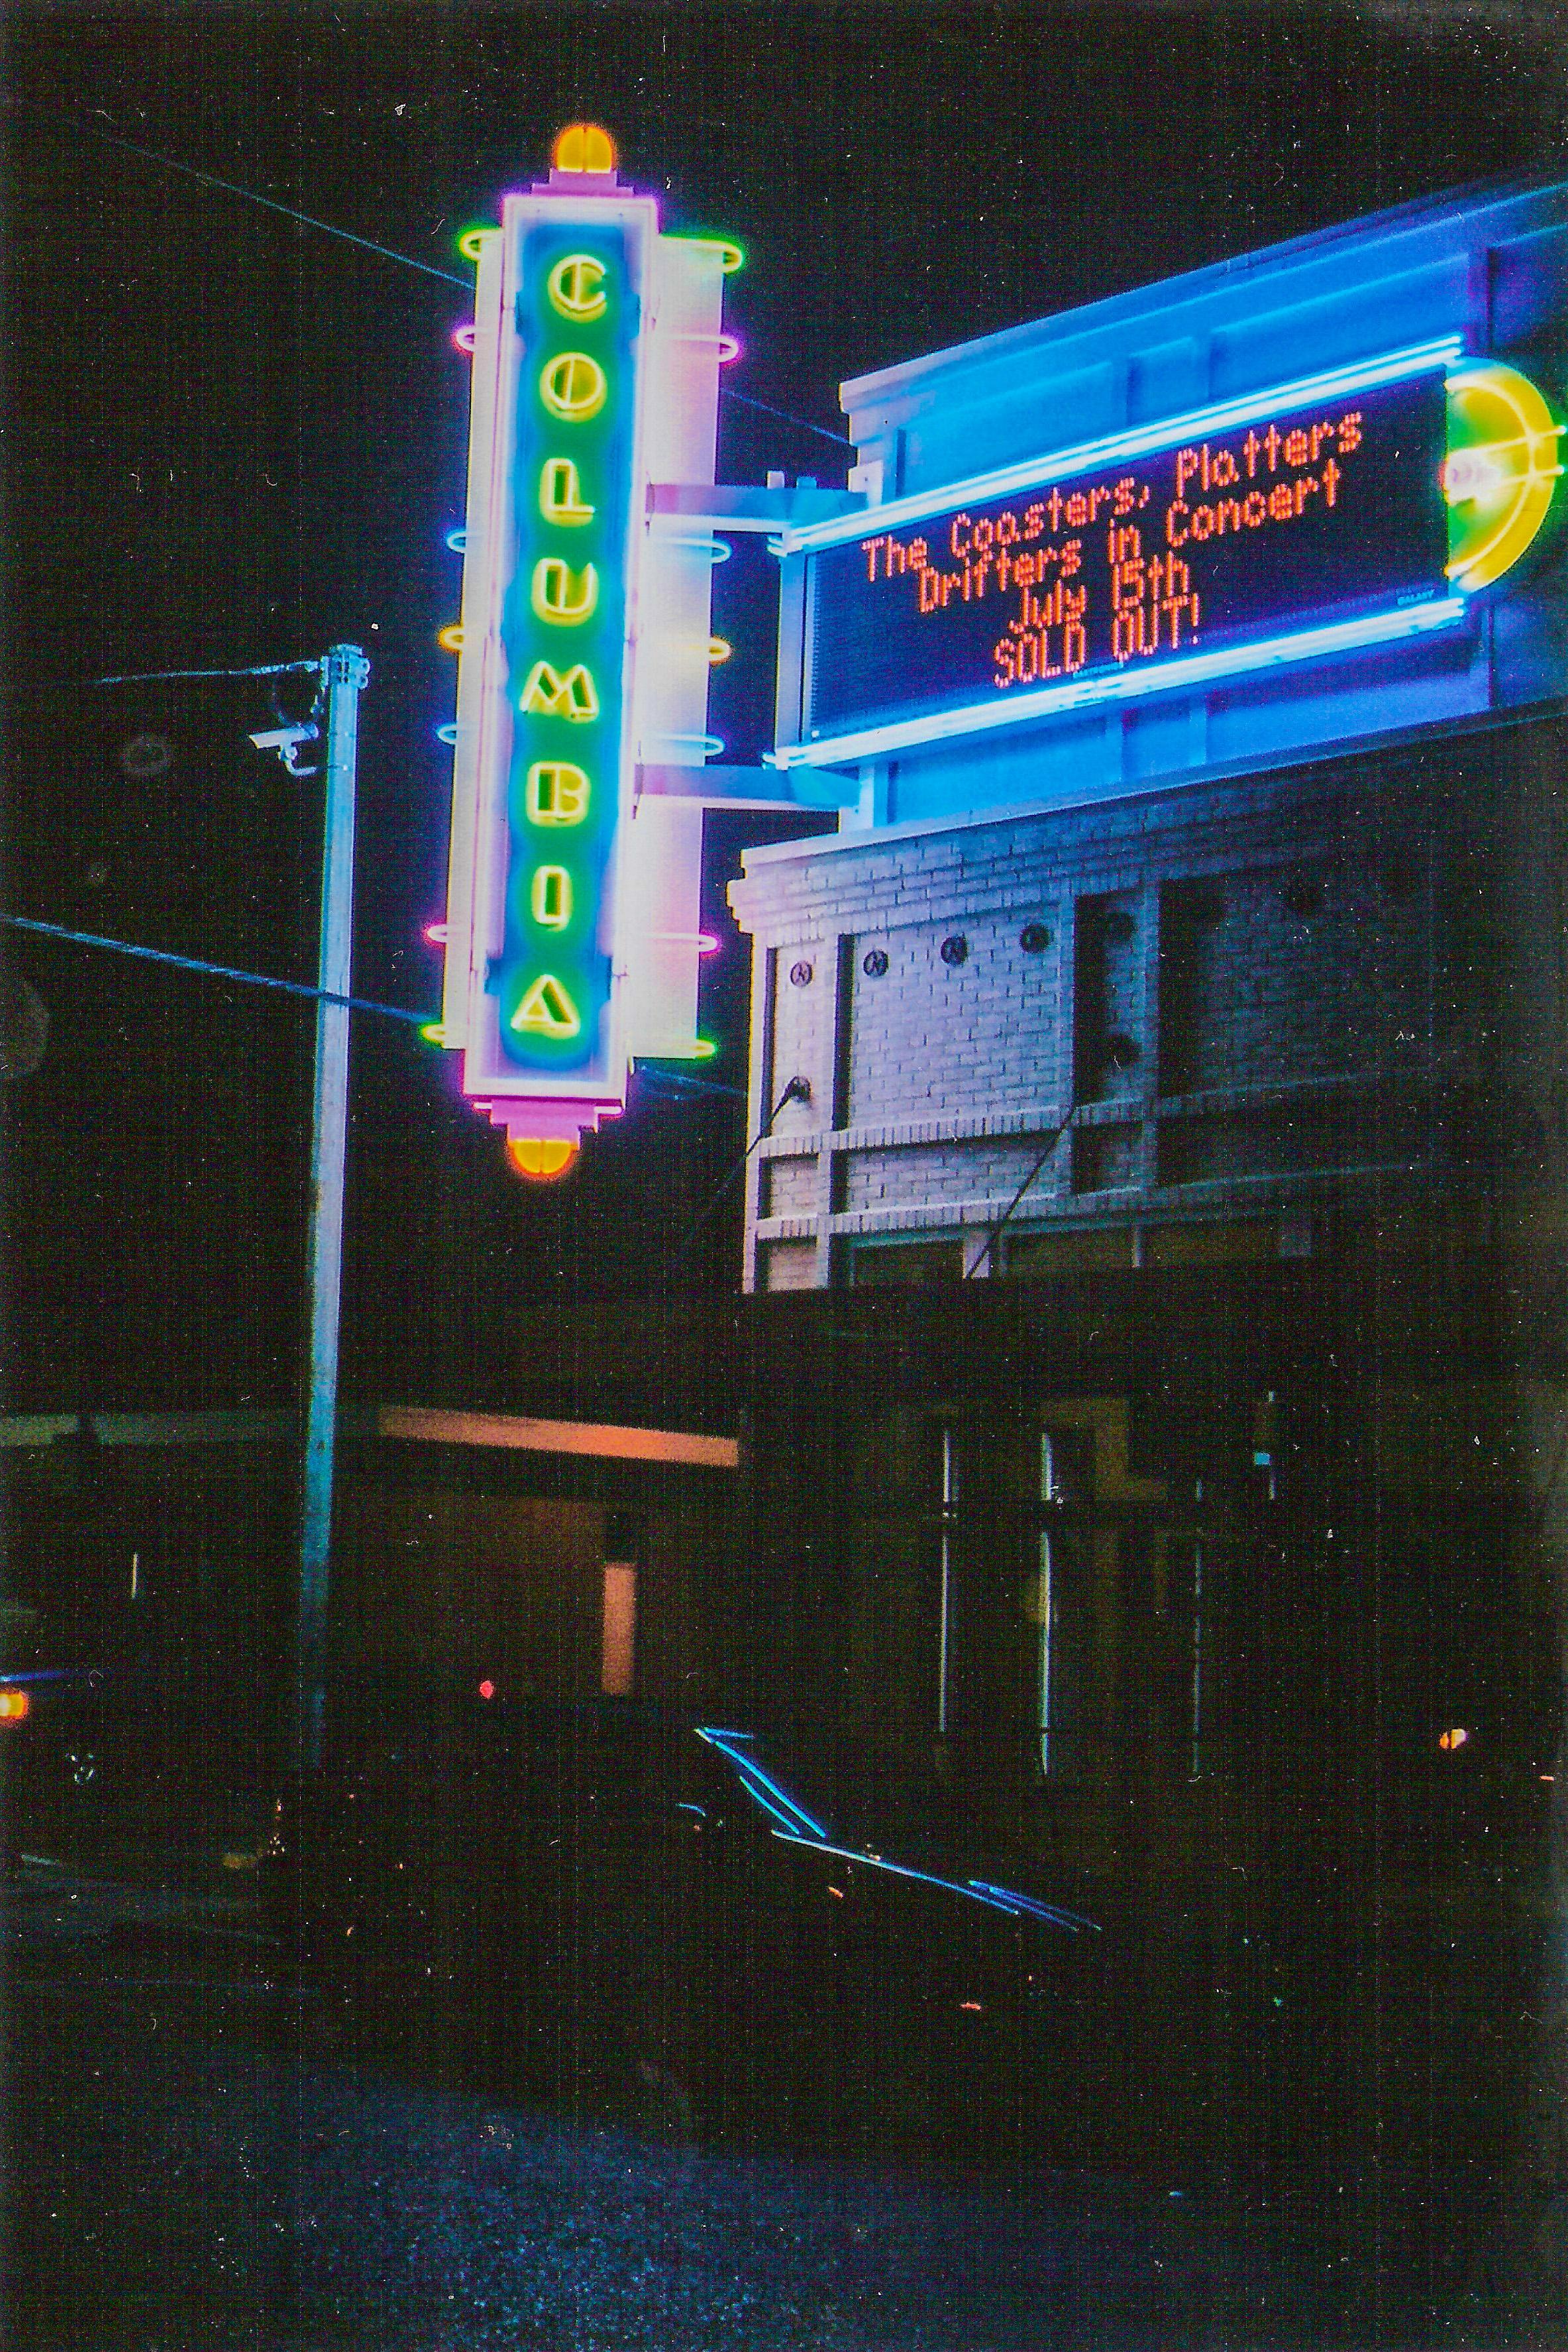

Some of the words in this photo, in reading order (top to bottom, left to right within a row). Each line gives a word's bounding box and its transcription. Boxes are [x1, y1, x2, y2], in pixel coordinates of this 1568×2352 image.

[861, 535, 927, 582] The
[951, 476, 1150, 558] Coasters,
[1176, 411, 1362, 498] Platters
[918, 538, 1082, 614] Drifters
[1108, 518, 1140, 563] in
[1165, 457, 1341, 548] Concert
[510, 253, 608, 1038] COLUMBIA
[994, 621, 1085, 688] SOLD
[1111, 592, 1201, 661] OUT!
[1008, 578, 1087, 634] July
[1110, 550, 1191, 610] 15th
